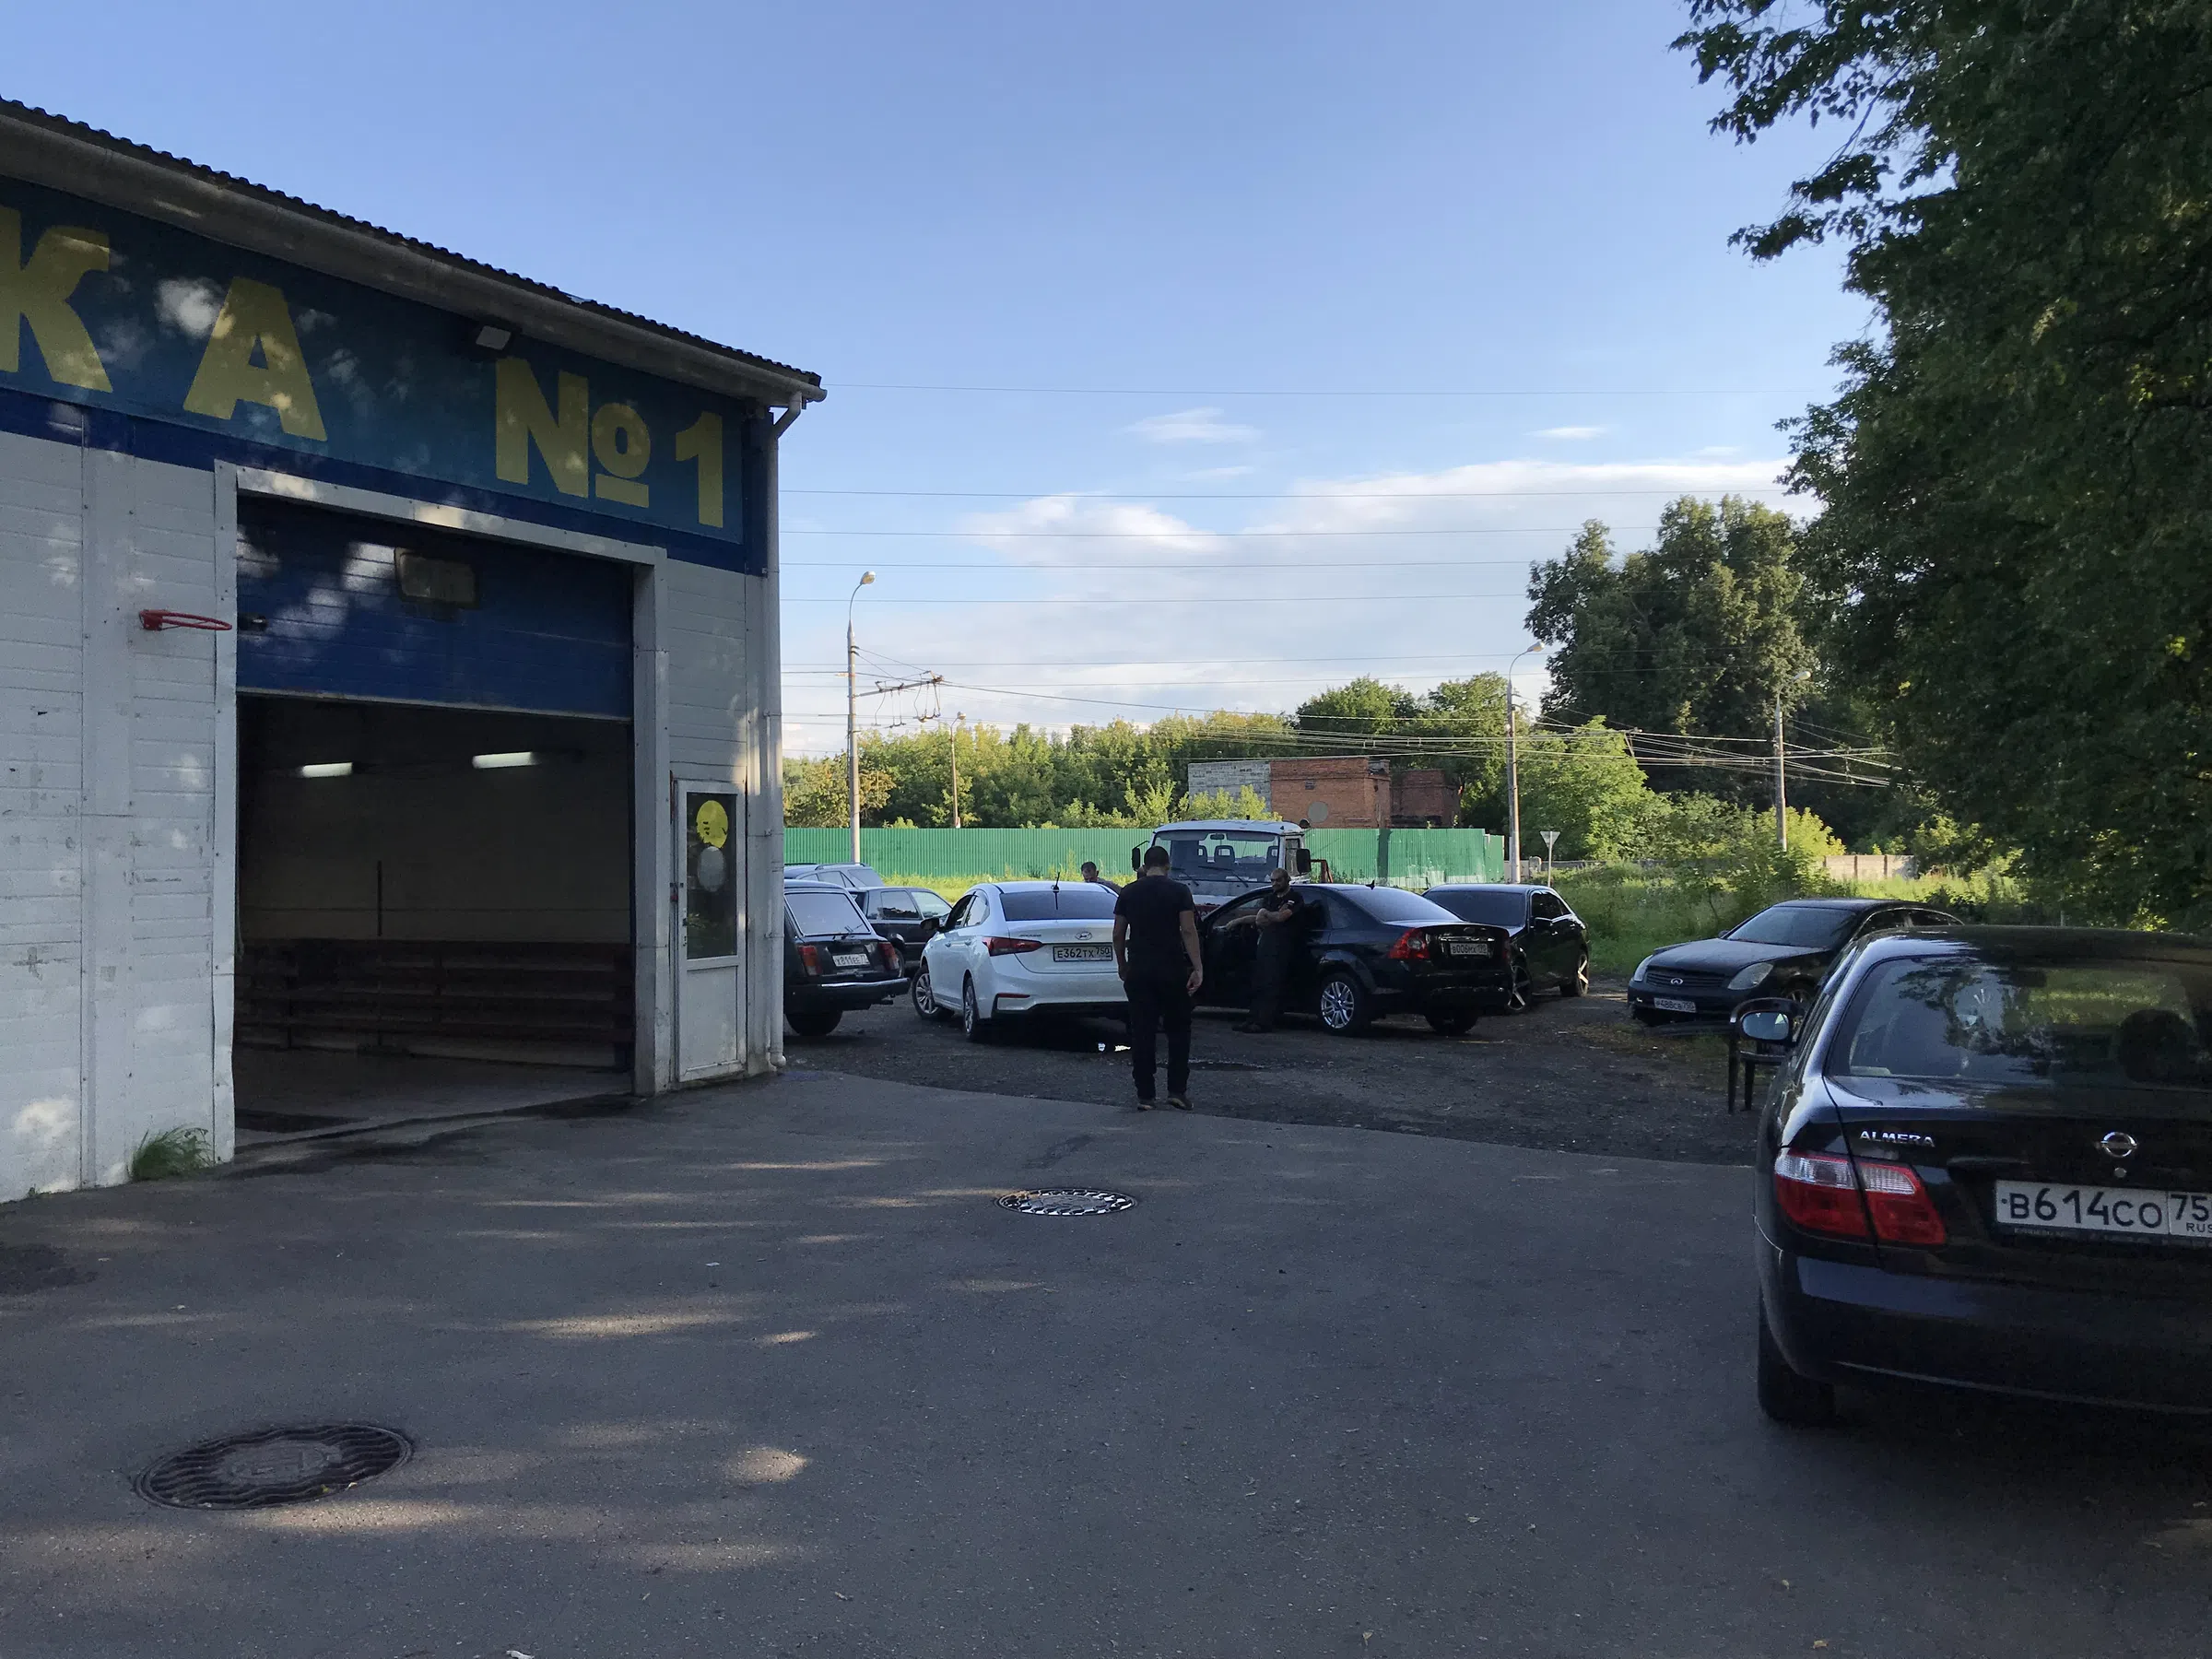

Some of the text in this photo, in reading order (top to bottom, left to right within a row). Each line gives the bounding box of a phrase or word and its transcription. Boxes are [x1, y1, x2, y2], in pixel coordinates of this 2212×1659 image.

[1859, 1130, 1936, 1147] ALMERA
[2009, 1187, 2212, 1229] В614СО 75
